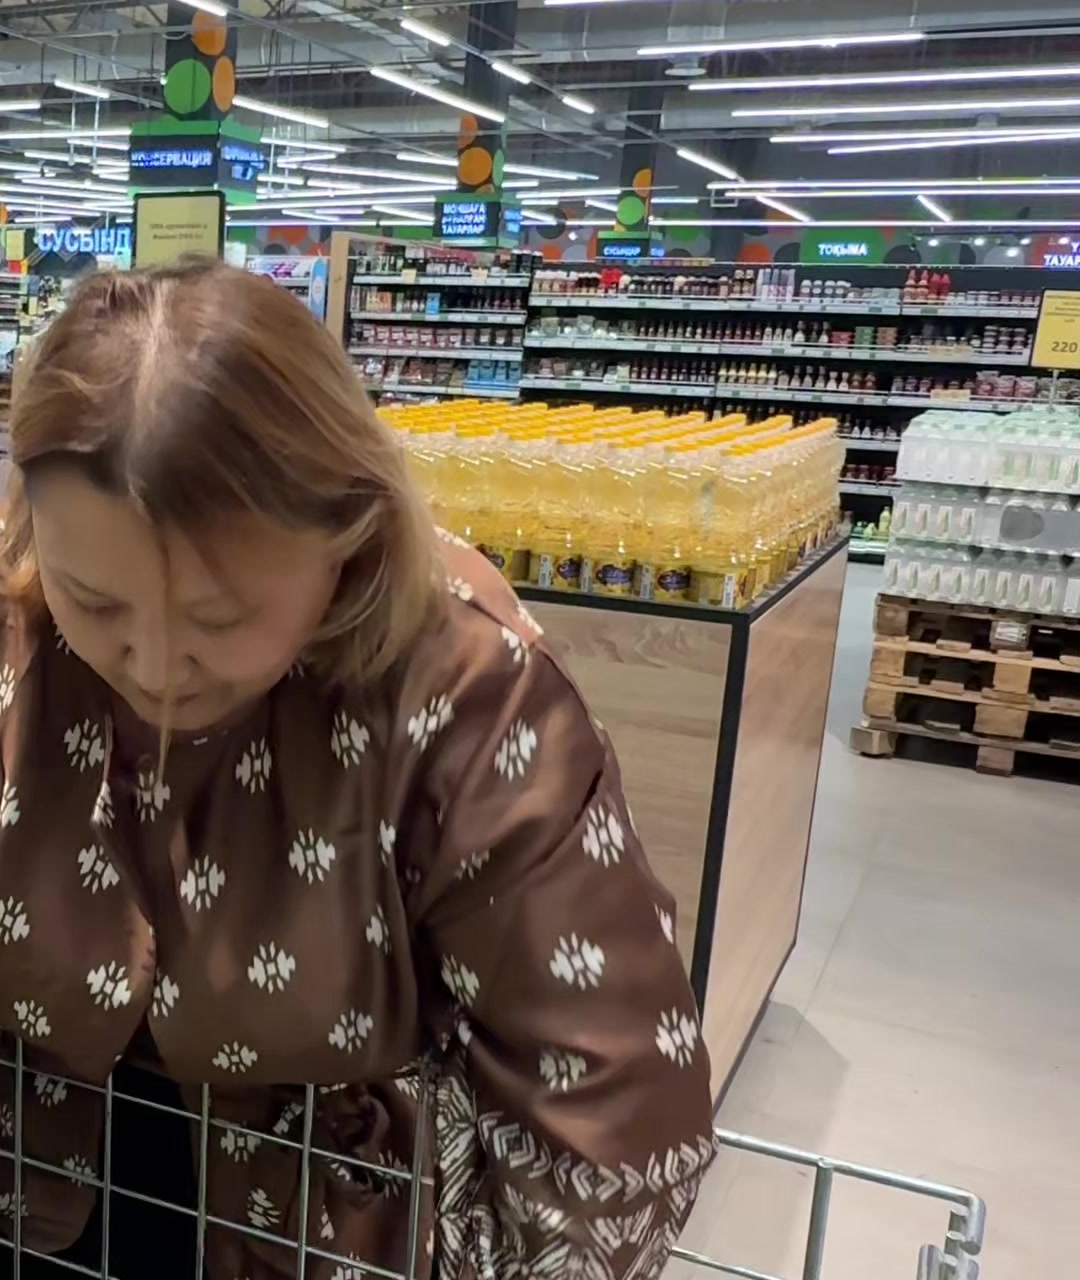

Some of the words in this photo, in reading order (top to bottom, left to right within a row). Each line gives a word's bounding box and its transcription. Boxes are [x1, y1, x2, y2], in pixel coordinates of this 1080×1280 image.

[38, 227, 131, 257] СУСЫНД
[1043, 254, 1080, 267] ТАУАР
[1051, 341, 1078, 353] 220
